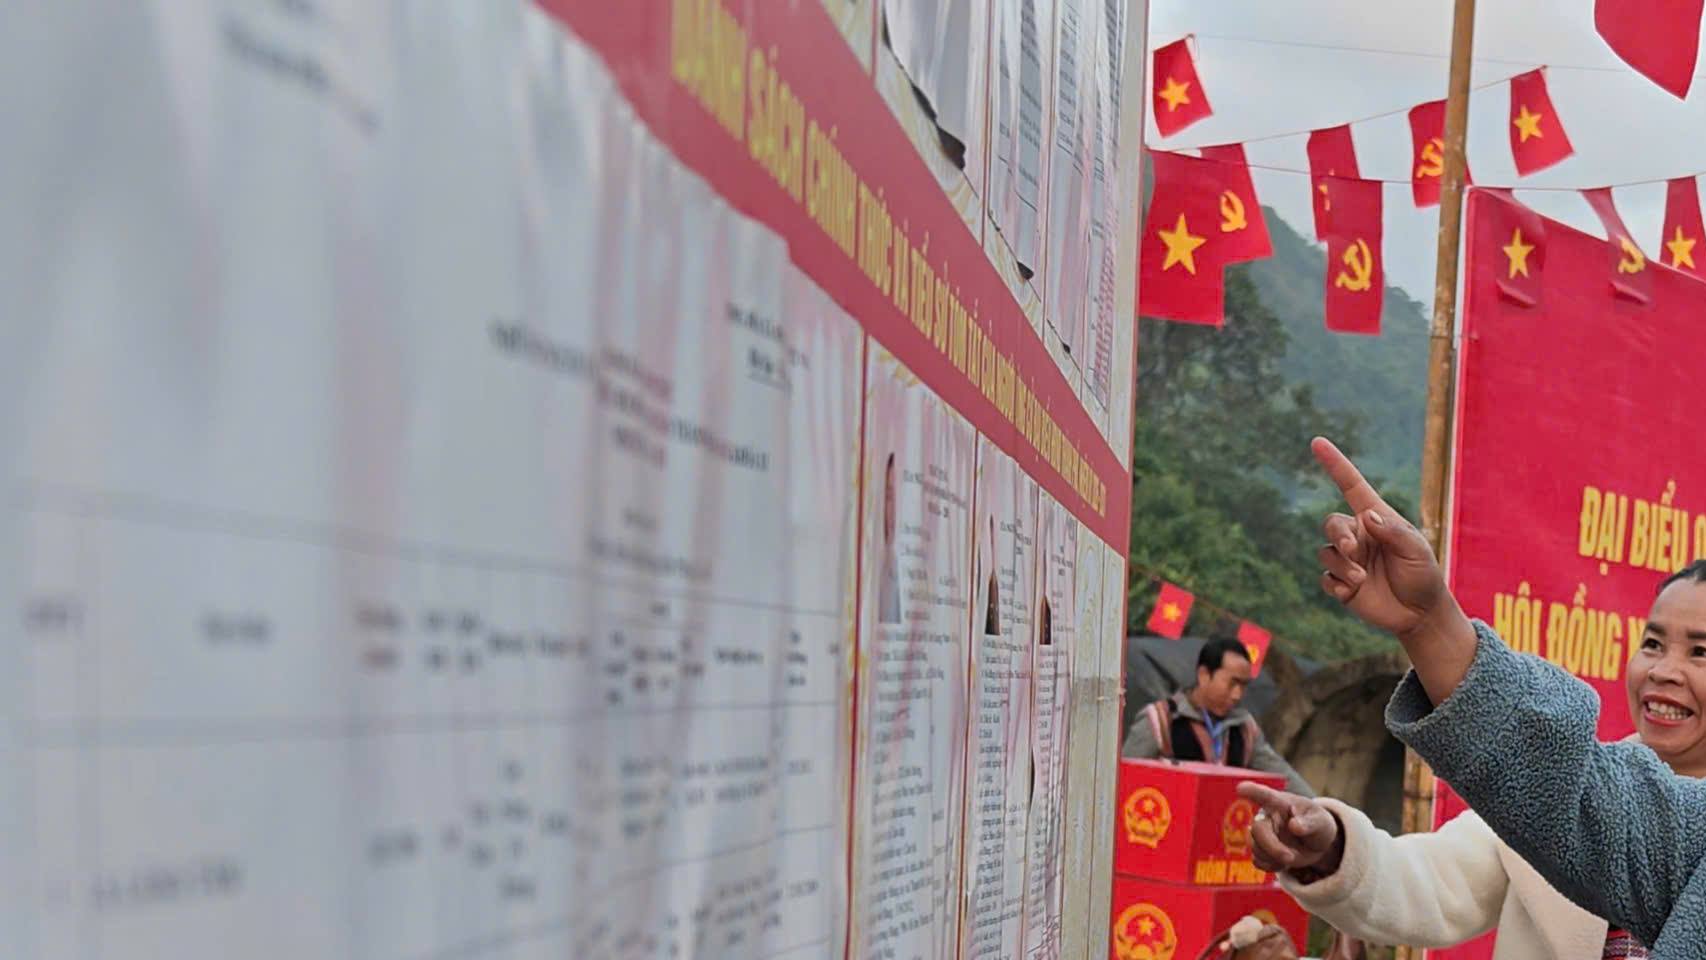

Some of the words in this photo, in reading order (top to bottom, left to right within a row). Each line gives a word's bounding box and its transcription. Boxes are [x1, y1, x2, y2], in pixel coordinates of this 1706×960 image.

[1578, 486, 1628, 576] ĐẠI
[1630, 479, 1689, 573] BIỂU
[1546, 582, 1622, 681] ĐỒNG
